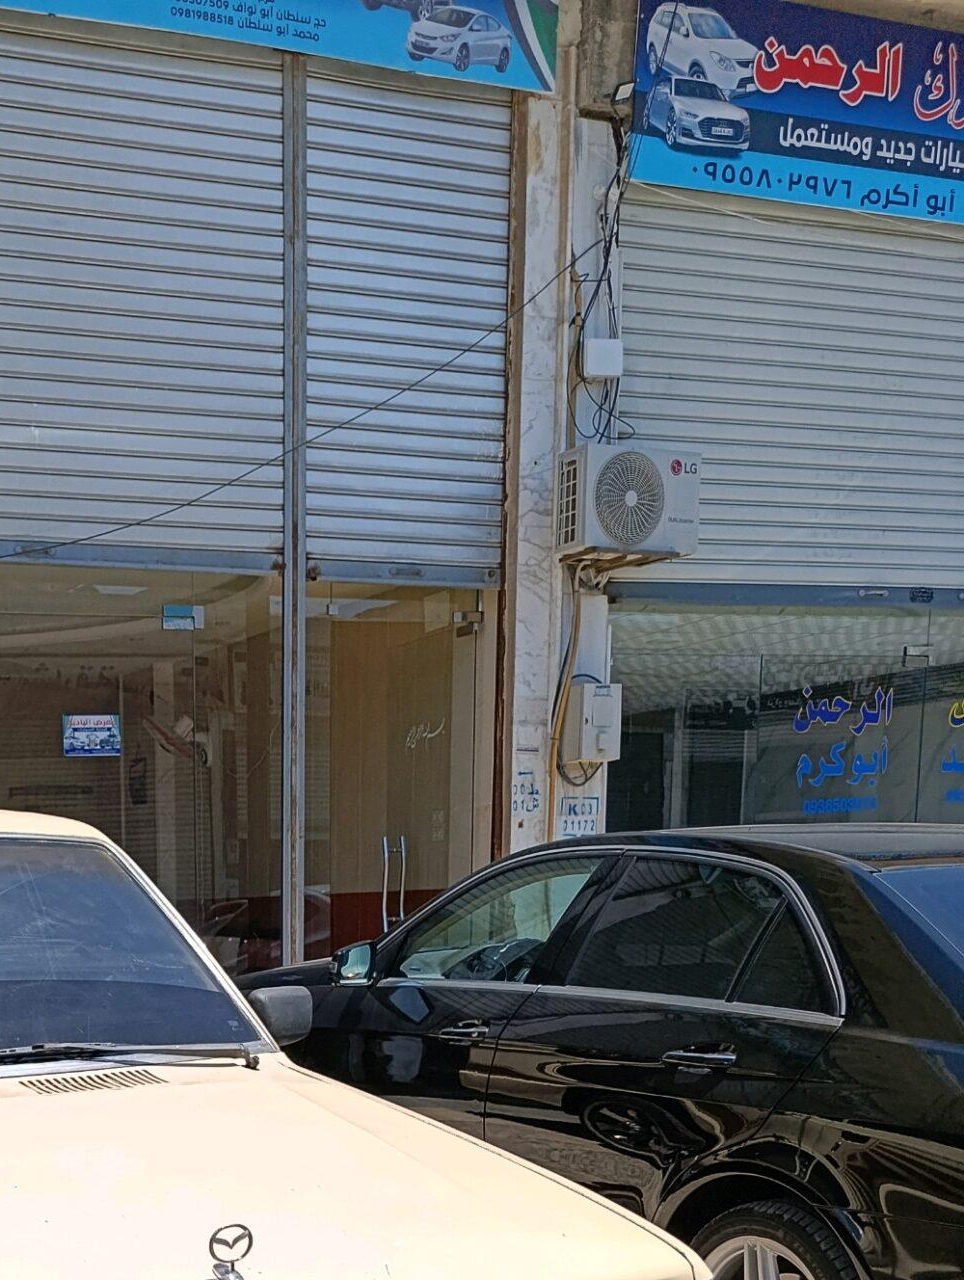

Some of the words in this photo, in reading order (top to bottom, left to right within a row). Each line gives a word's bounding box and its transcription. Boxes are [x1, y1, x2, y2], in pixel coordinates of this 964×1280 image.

[753, 36, 903, 107] الرحمن
[779, 117, 873, 161] ومستعمل
[876, 139, 916, 167] جديد
[920, 139, 964, 174] يارات
[859, 183, 919, 210] أكرم
[925, 187, 956, 216] أبو
[684, 462, 698, 474] LG
[792, 684, 894, 736] الرحمن
